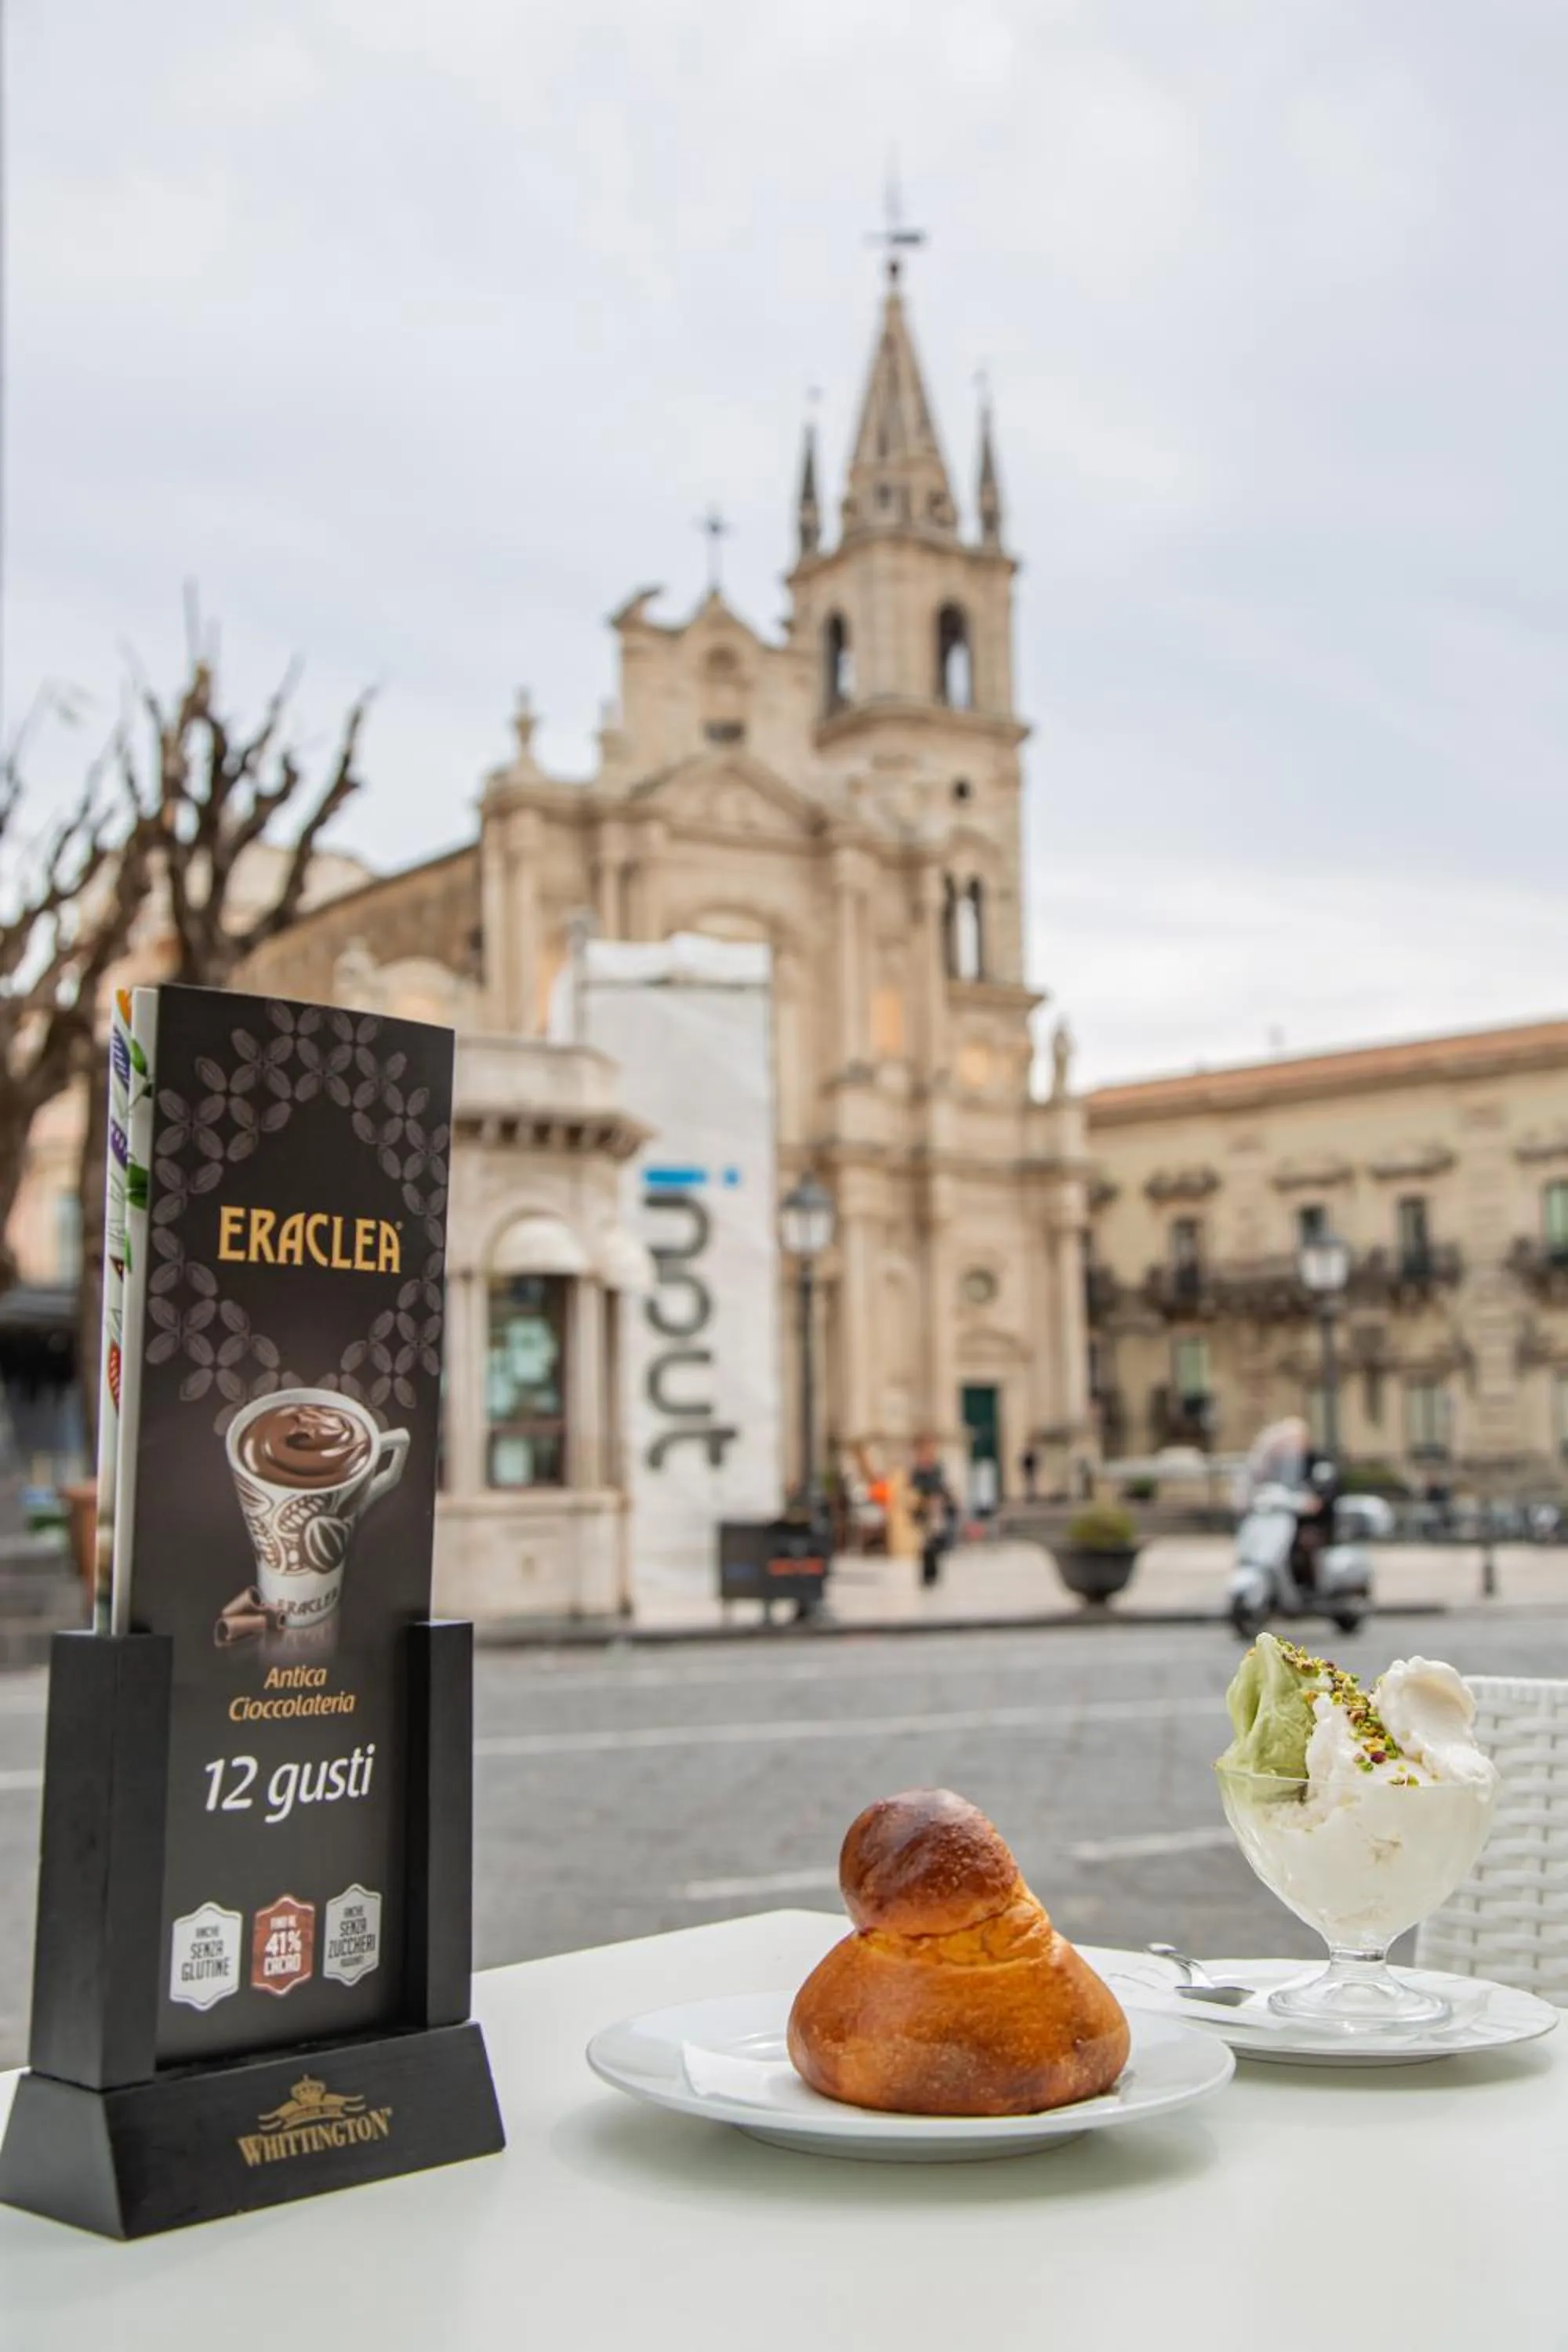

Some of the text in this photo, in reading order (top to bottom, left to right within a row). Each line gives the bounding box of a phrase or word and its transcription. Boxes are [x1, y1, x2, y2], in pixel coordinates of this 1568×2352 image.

[217, 1204, 401, 1274] ERACLEA
[263, 1664, 328, 1690] Antica
[228, 1690, 356, 1722] Cioccolateria
[204, 1742, 376, 1824] 12 gusti
[190, 1940, 224, 1959] SENZA
[264, 1929, 302, 1956] 41%
[328, 1933, 376, 1958] ZUCCHERI
[181, 1957, 231, 1981] GLUTINE
[238, 2107, 393, 2167] WHITTINGTON
